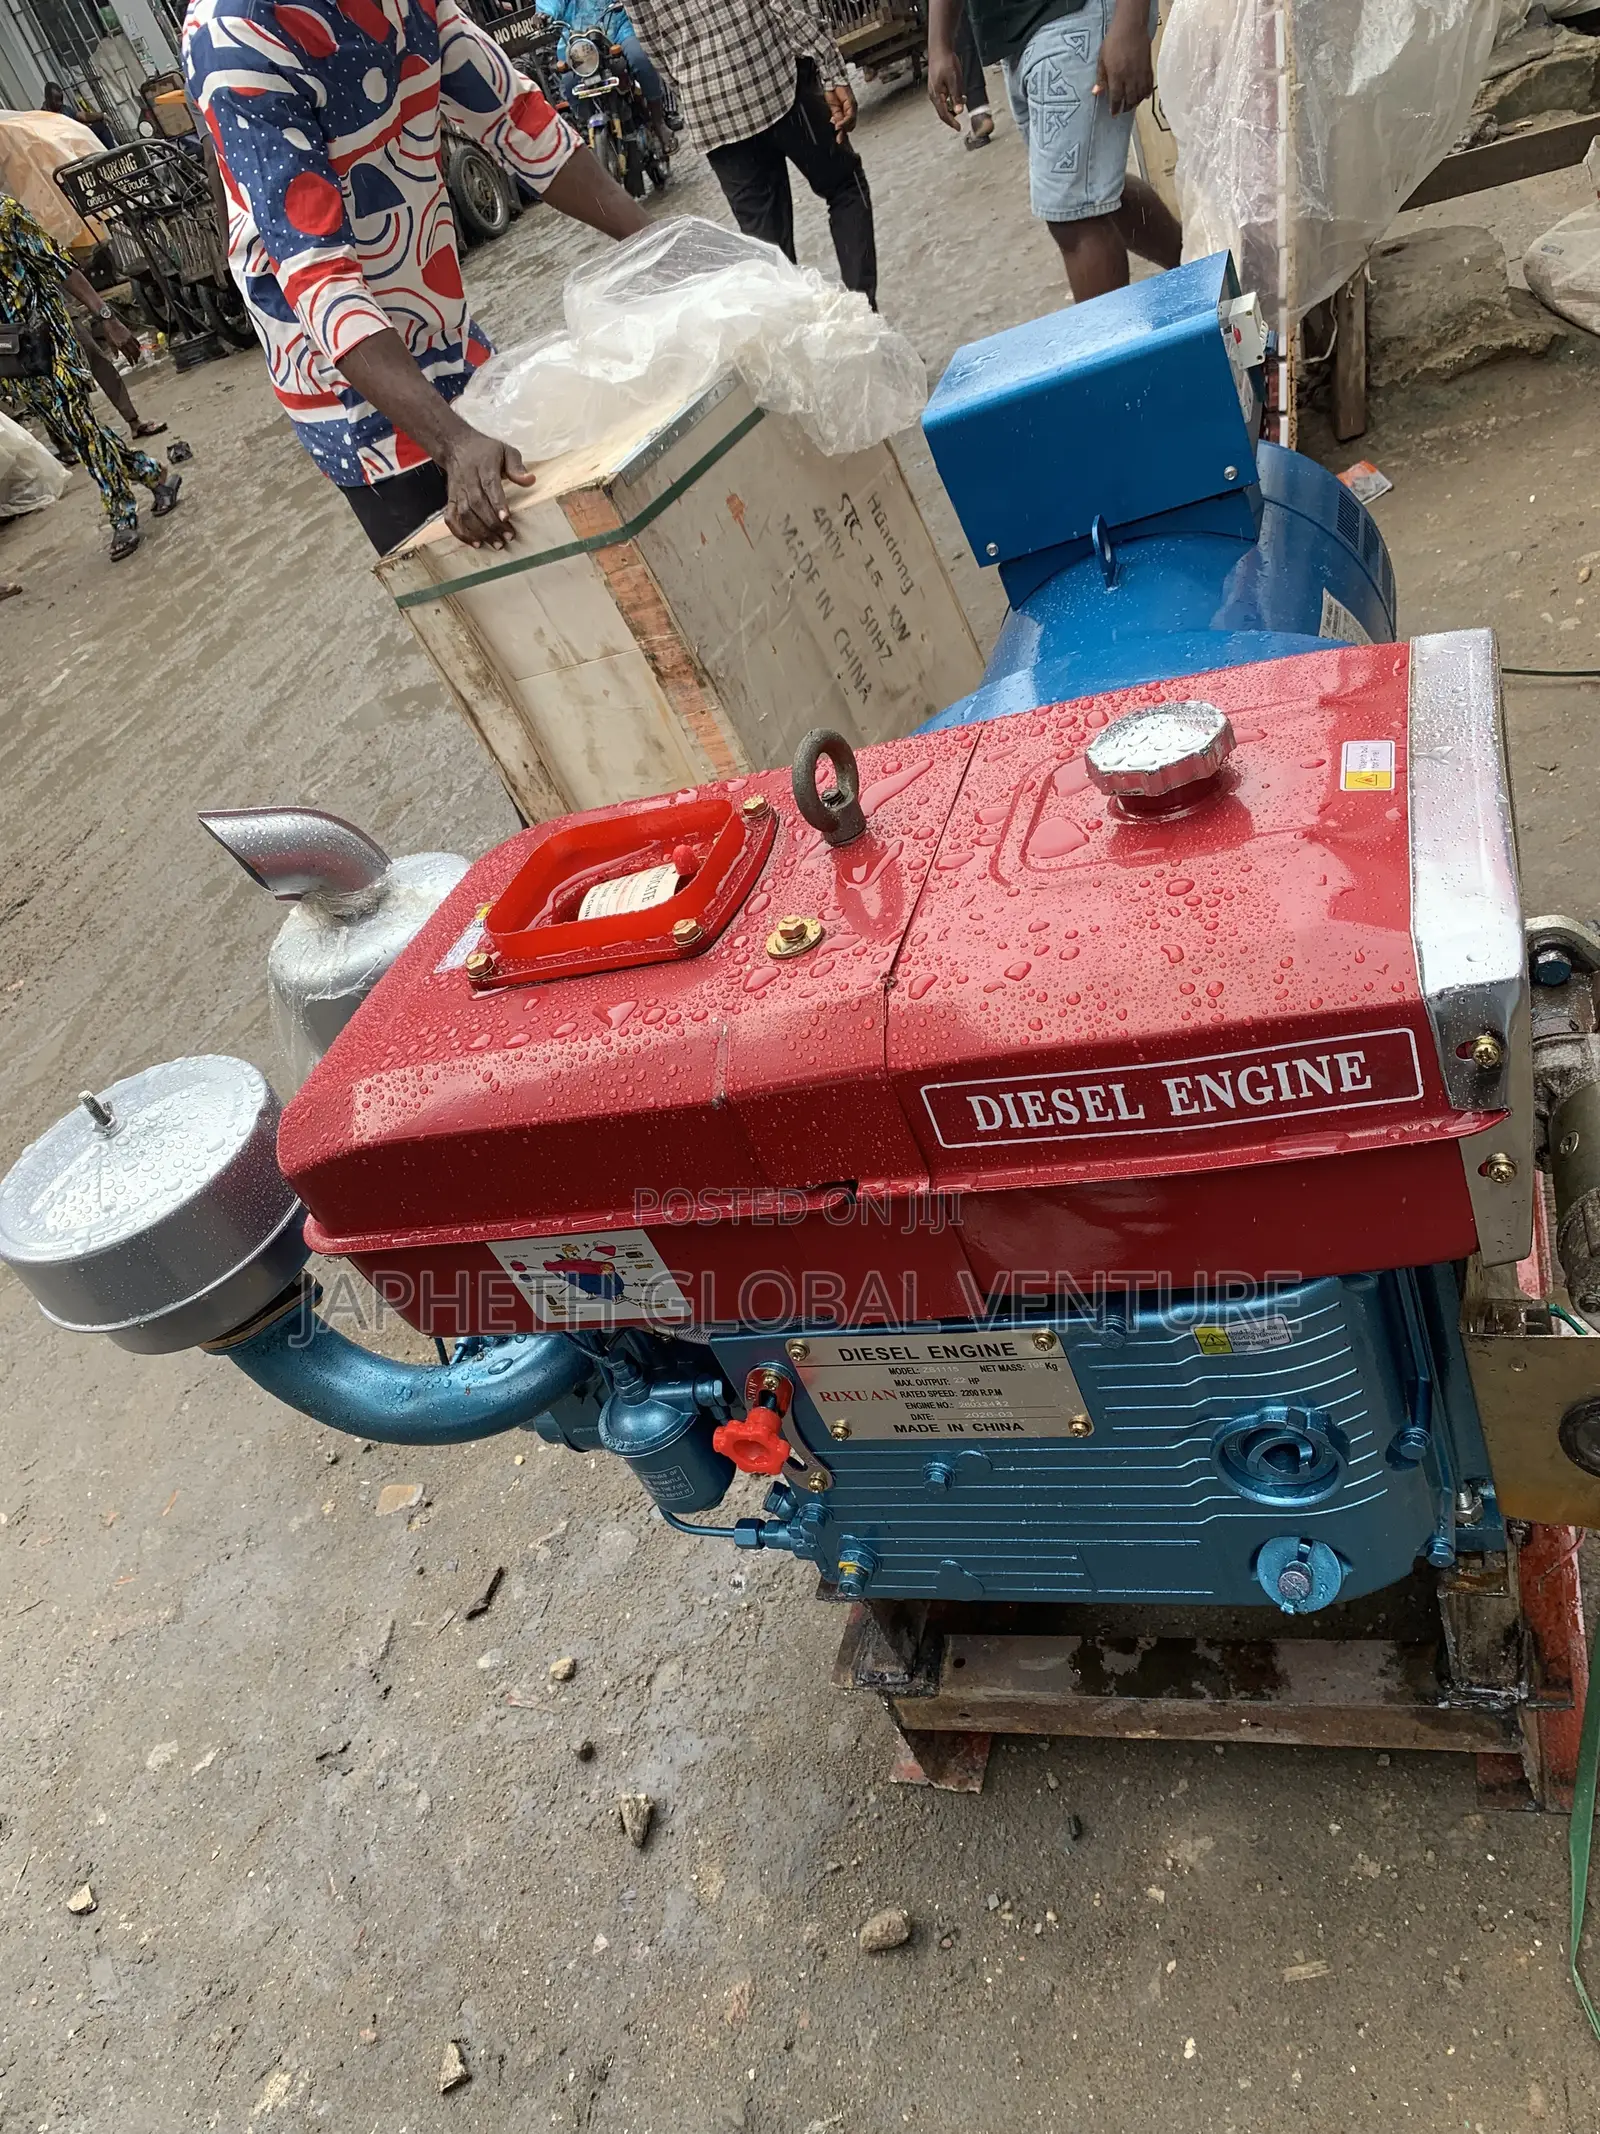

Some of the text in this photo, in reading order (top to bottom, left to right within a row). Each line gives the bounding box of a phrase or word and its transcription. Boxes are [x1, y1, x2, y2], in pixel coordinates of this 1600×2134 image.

[493, 28, 510, 45] NO
[77, 171, 96, 191] NO
[128, 175, 150, 191] POLICE
[815, 588, 835, 622] IN
[833, 627, 873, 704] CHINA
[966, 1049, 1372, 1131] DIESEL ENGINE
[838, 1342, 1018, 1362] DIESEL ENGINE
[888, 1367, 920, 1376] MODEL:
[979, 1364, 996, 1373] NET
[998, 1363, 1027, 1373] MASS:
[1044, 1362, 1059, 1372] Kg
[894, 1378, 915, 1387] MAX.
[915, 1377, 951, 1387] OUTPUT:
[968, 1377, 981, 1385] HP
[819, 1389, 898, 1403] RIXUAN
[899, 1388, 1003, 1399] RATED SPEED: 2200 R.P.M
[905, 1401, 937, 1410] ENGINE
[910, 1413, 936, 1421] DATE:
[893, 1421, 1025, 1433] MADE IN CHINA
